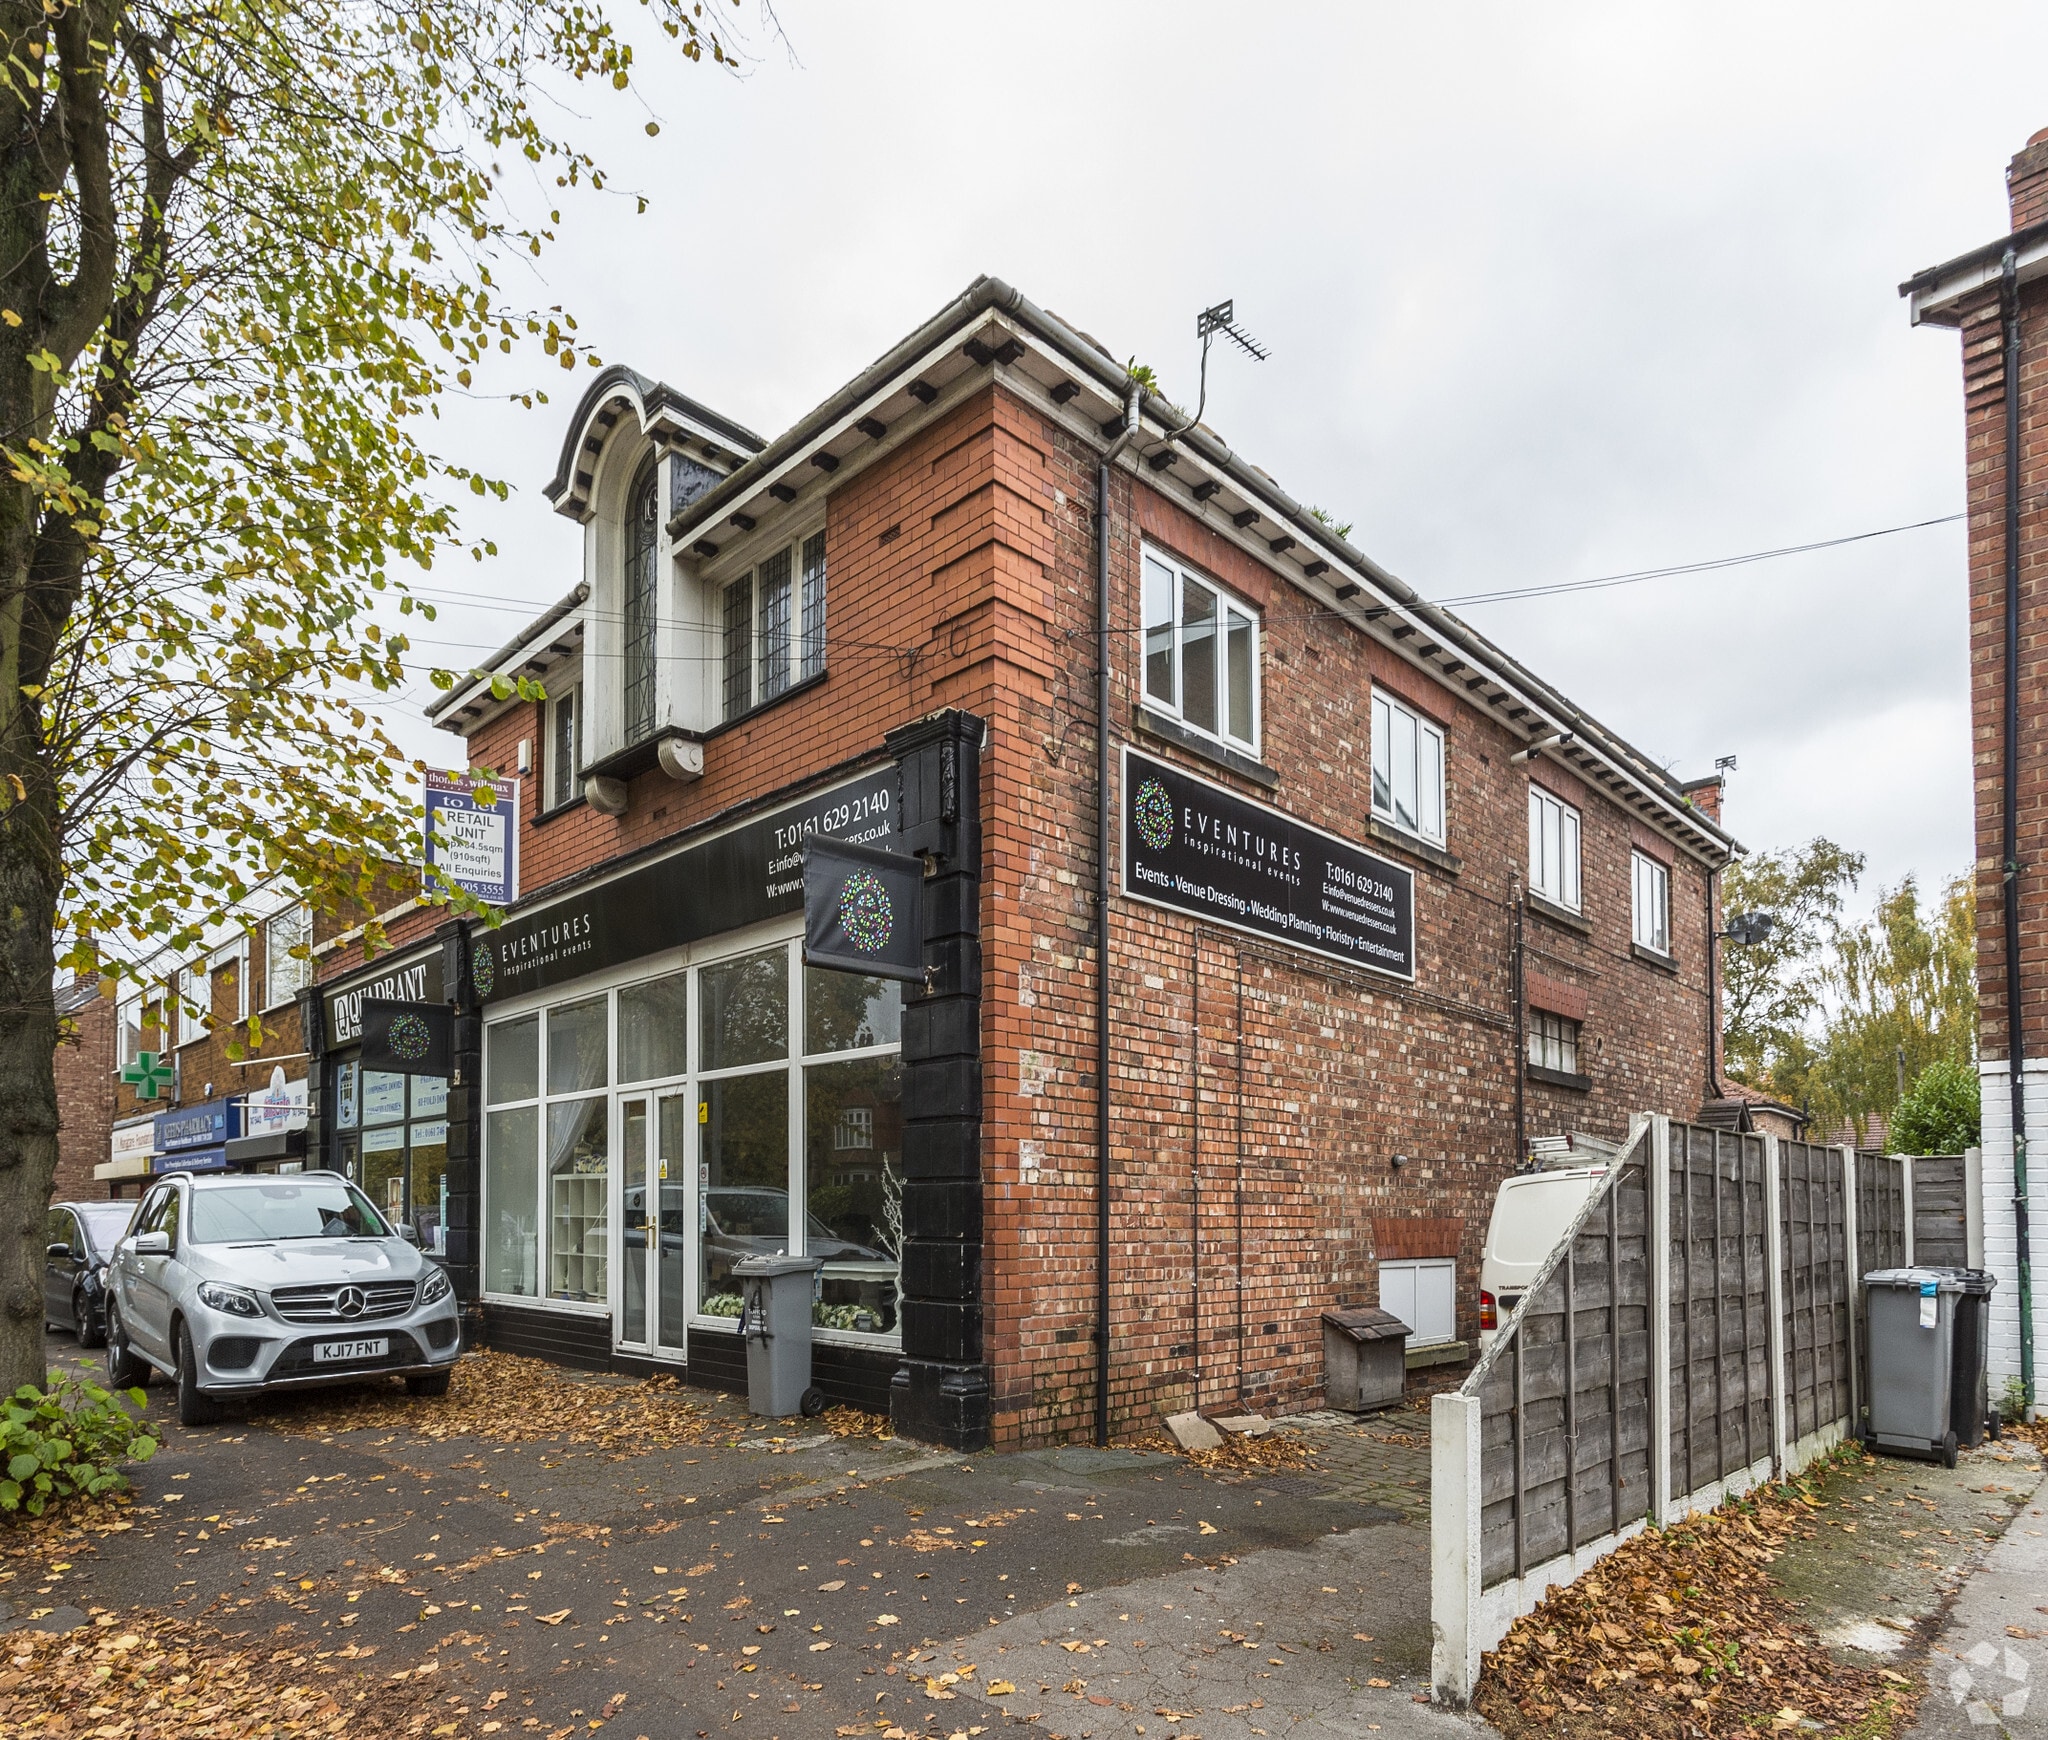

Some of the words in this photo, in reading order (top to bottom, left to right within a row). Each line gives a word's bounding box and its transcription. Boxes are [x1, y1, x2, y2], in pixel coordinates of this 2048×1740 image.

[443, 795, 463, 807] to
[447, 811, 495, 828] RETAIL
[775, 815, 818, 850] T:0161
[823, 804, 849, 832] 629
[853, 788, 890, 822] 2140
[455, 826, 486, 840] UNIT
[1184, 807, 1301, 870] EVENTURES
[439, 862, 452, 872] All
[455, 864, 502, 878] Enquiries
[450, 852, 491, 866] (910sqft)
[1184, 832, 1262, 872] inspirational
[1267, 865, 1301, 886] events
[460, 882, 478, 892] 905
[481, 884, 504, 896] 3555
[1325, 861, 1355, 888] T:0161
[1357, 875, 1373, 894] 629
[1374, 881, 1394, 902] 2140
[1135, 861, 1170, 888] Events
[1175, 875, 1206, 900] Venue
[1207, 886, 1246, 915] Dressing
[1250, 900, 1288, 928] Wedding
[1288, 912, 1322, 940] Planning
[1326, 926, 1355, 950] Floristry
[1358, 936, 1405, 963] Entertainment
[502, 914, 590, 962] EVENTURES
[503, 948, 558, 976] inspirational
[562, 940, 592, 957] events
[323, 1343, 354, 1358] KJ17
[356, 1340, 380, 1356] FNT
